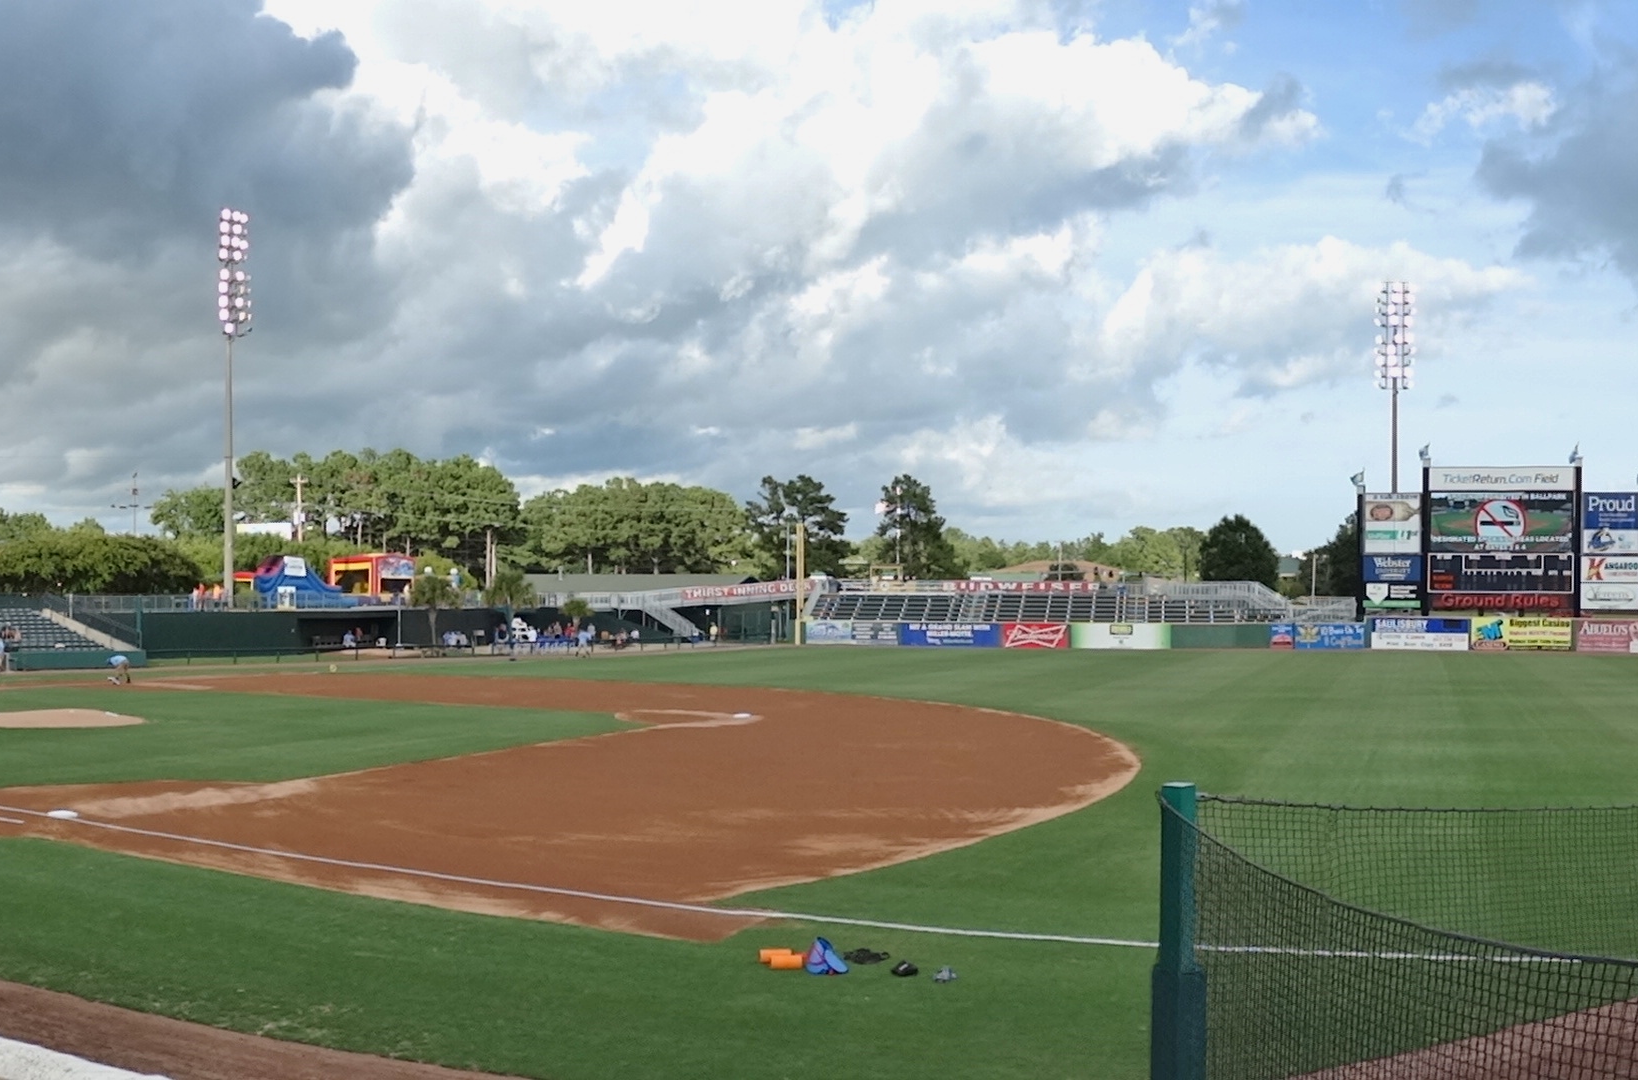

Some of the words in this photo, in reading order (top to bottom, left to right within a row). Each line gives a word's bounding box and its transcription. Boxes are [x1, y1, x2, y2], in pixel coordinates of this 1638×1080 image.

[1533, 473, 1559, 484] Field
[1588, 495, 1635, 511] Proud
[1536, 535, 1570, 543] LOCATED
[1373, 557, 1411, 568] Webster
[943, 582, 1101, 592] BUDWEISER
[1441, 593, 1505, 607] Ground
[1510, 593, 1560, 607] Rules
[1509, 618, 1541, 628] Biggest
[1579, 620, 1629, 635] ABUELO'S
